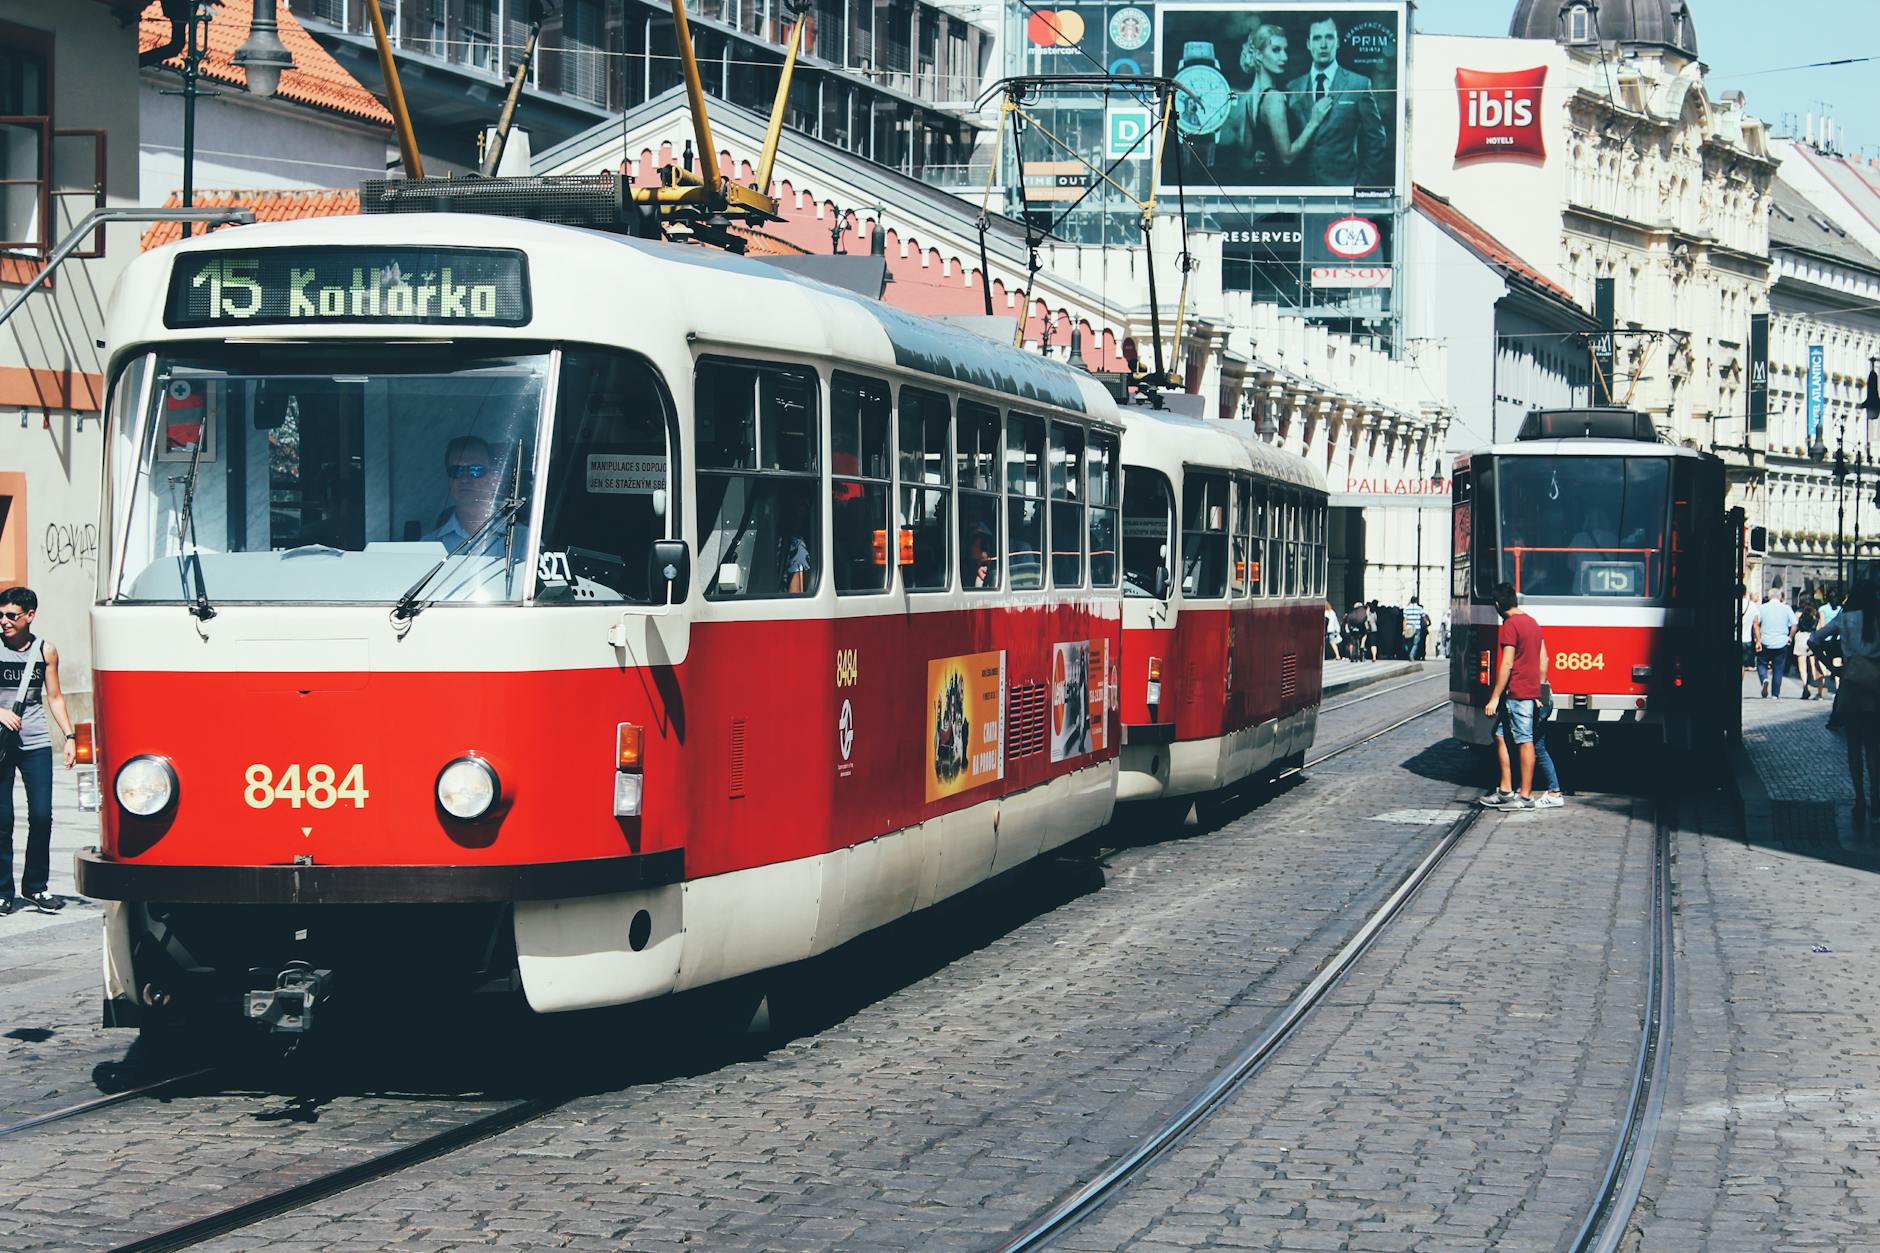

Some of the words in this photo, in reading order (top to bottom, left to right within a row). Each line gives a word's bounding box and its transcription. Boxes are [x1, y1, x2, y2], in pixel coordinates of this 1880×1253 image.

[1352, 36, 1388, 46] PRIM
[1468, 90, 1532, 127] ibis
[1485, 136, 1514, 145] HOTELS
[1058, 176, 1087, 185] OUT
[1222, 231, 1301, 243] RESERVED
[1335, 228, 1369, 247] C&A
[1312, 267, 1389, 288] orsay
[193, 259, 263, 318] 15
[1811, 354, 1822, 402] ATLANTIC
[592, 461, 634, 471] MANIPULACE
[634, 462, 640, 472] S
[591, 478, 603, 488] JEN
[604, 479, 614, 489] SE
[615, 476, 652, 489] STAŽENÝM
[537, 551, 572, 581] 327
[1597, 570, 1628, 590] 15
[836, 649, 858, 688] 8484
[1555, 652, 1605, 670] 8684
[3, 669, 42, 681] GUSS
[244, 763, 369, 809] 8484
